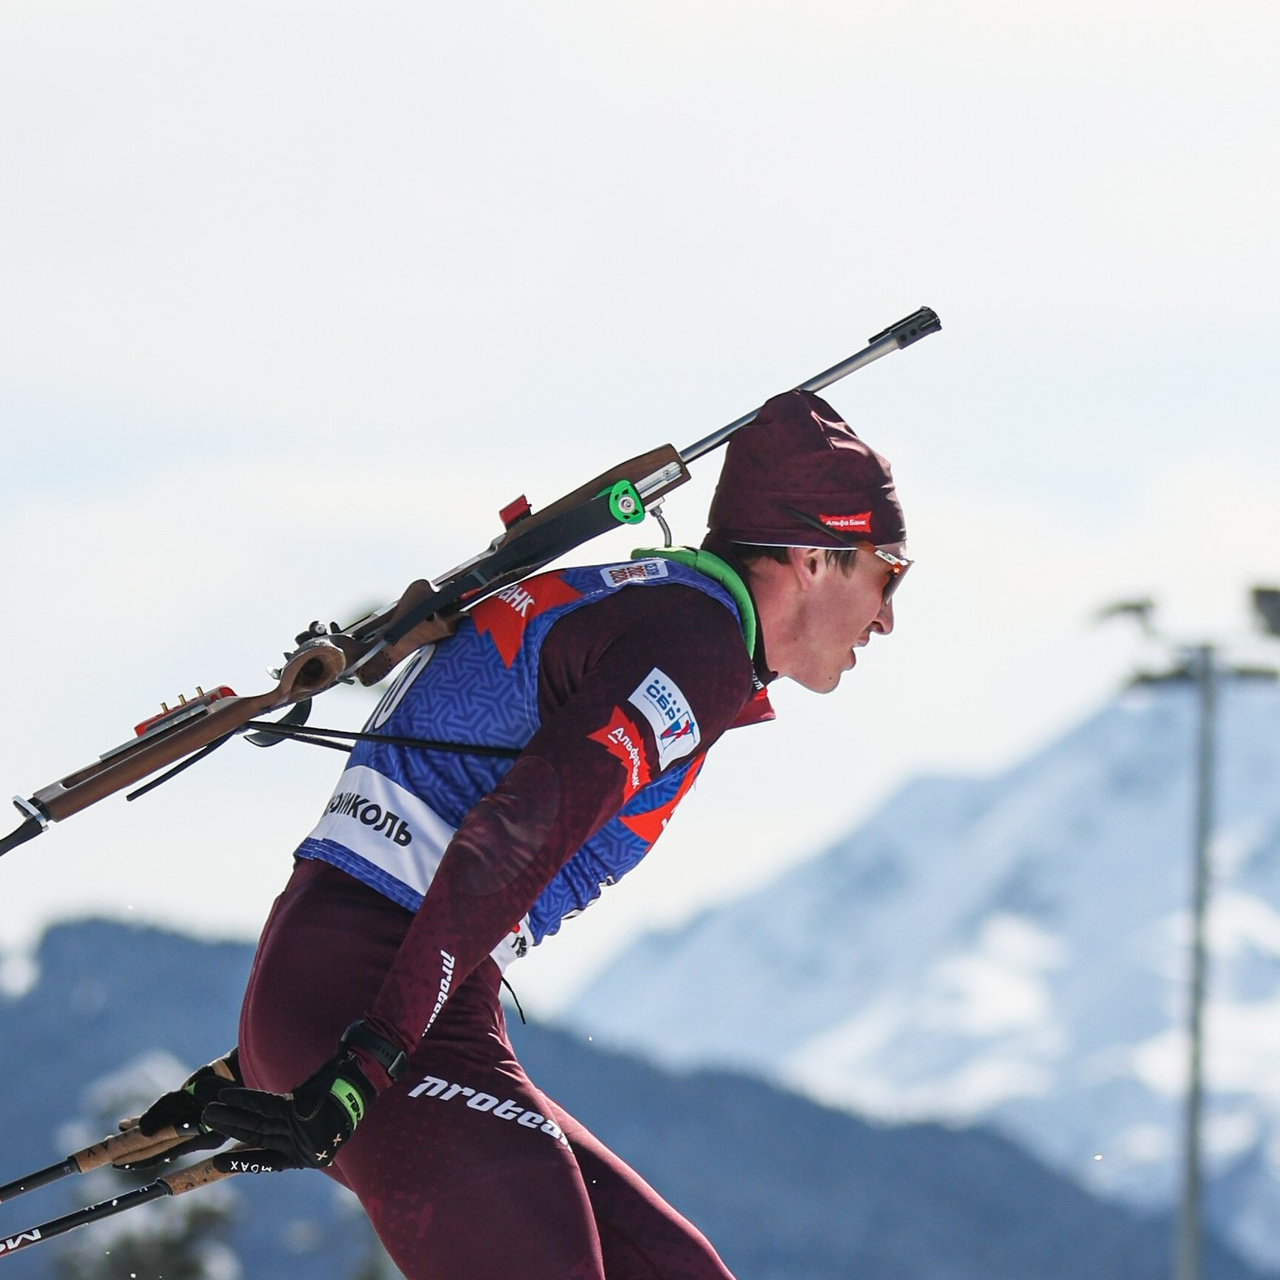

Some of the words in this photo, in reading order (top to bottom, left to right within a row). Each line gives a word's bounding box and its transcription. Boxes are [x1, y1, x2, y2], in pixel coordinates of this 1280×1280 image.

[495, 585, 535, 618] анк
[646, 684, 677, 721] СБР
[230, 1160, 272, 1174] MOAX
